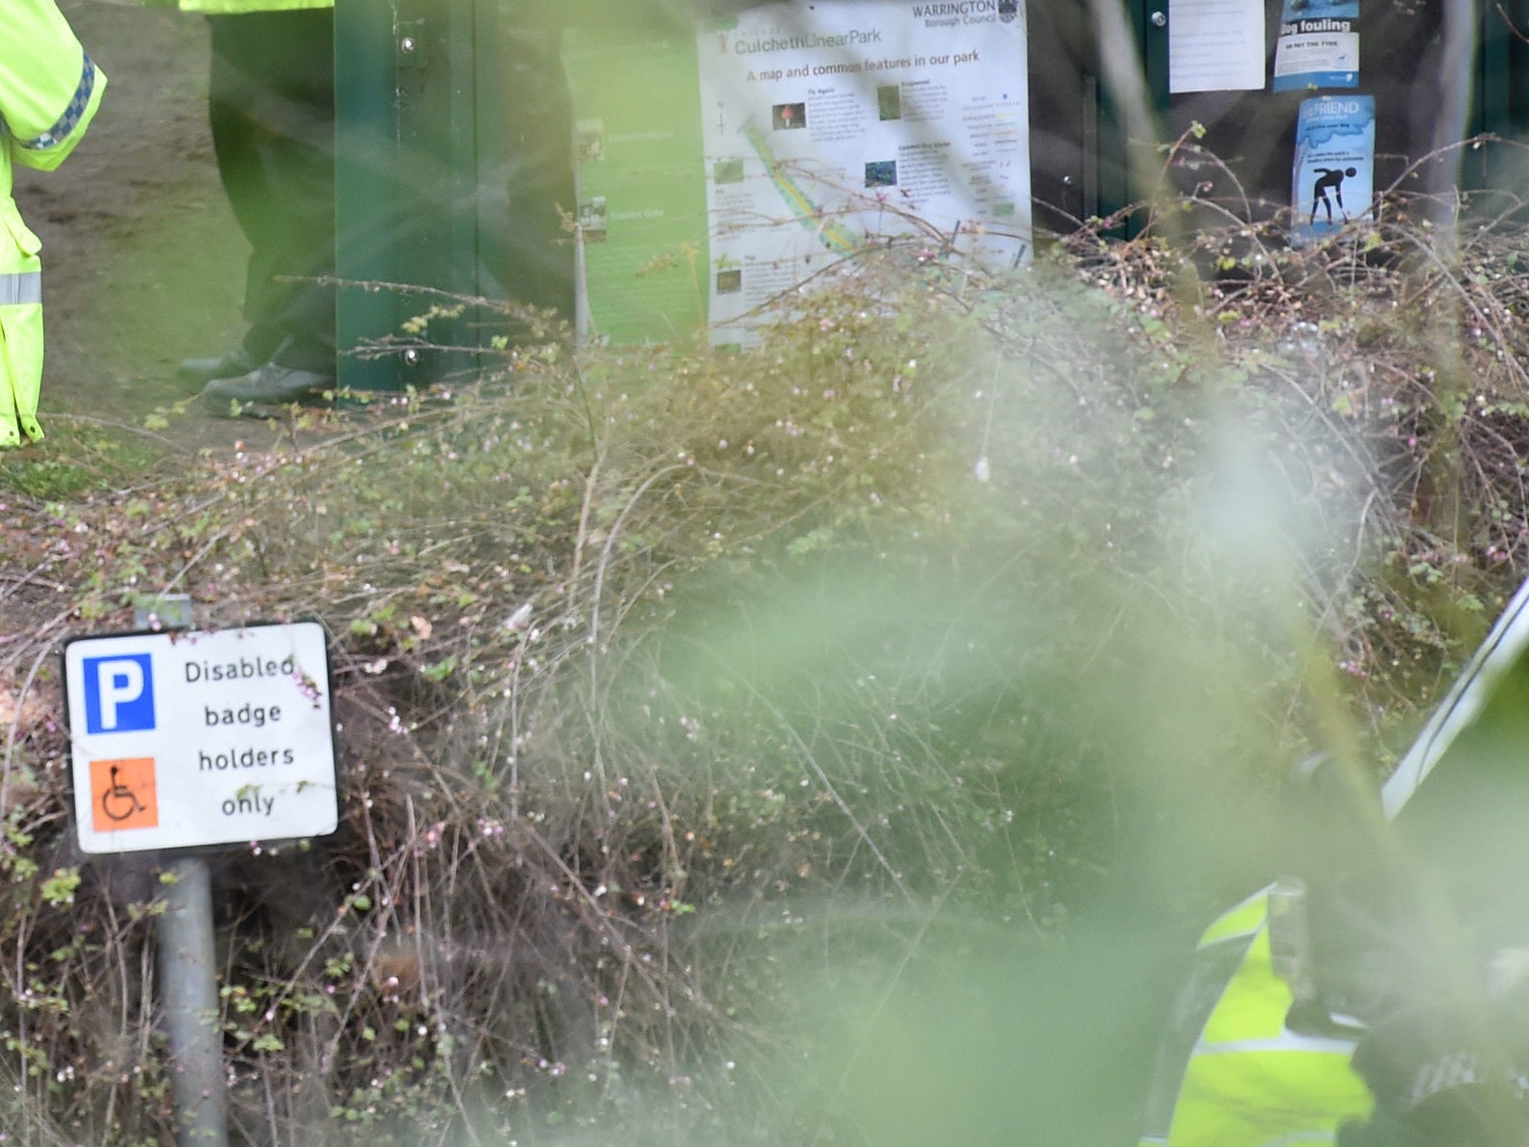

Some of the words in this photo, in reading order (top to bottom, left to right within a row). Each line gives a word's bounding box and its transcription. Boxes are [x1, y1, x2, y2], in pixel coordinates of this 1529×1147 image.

[912, 0, 996, 17] WARRINGTON
[924, 17, 960, 28] Borough
[962, 14, 997, 24] Council
[1300, 19, 1351, 32] fouling
[734, 27, 881, 54] CulchethLinearPark
[746, 70, 756, 81] A
[760, 69, 783, 82] map
[786, 64, 810, 78] and
[813, 61, 861, 76] common
[863, 58, 911, 72] features
[914, 53, 926, 66] in
[929, 54, 950, 65] our
[953, 49, 980, 66] park
[185, 657, 295, 683] Disabled
[97, 659, 144, 730] P
[205, 703, 282, 728] badge
[198, 748, 295, 771] holders
[222, 793, 275, 818] only
